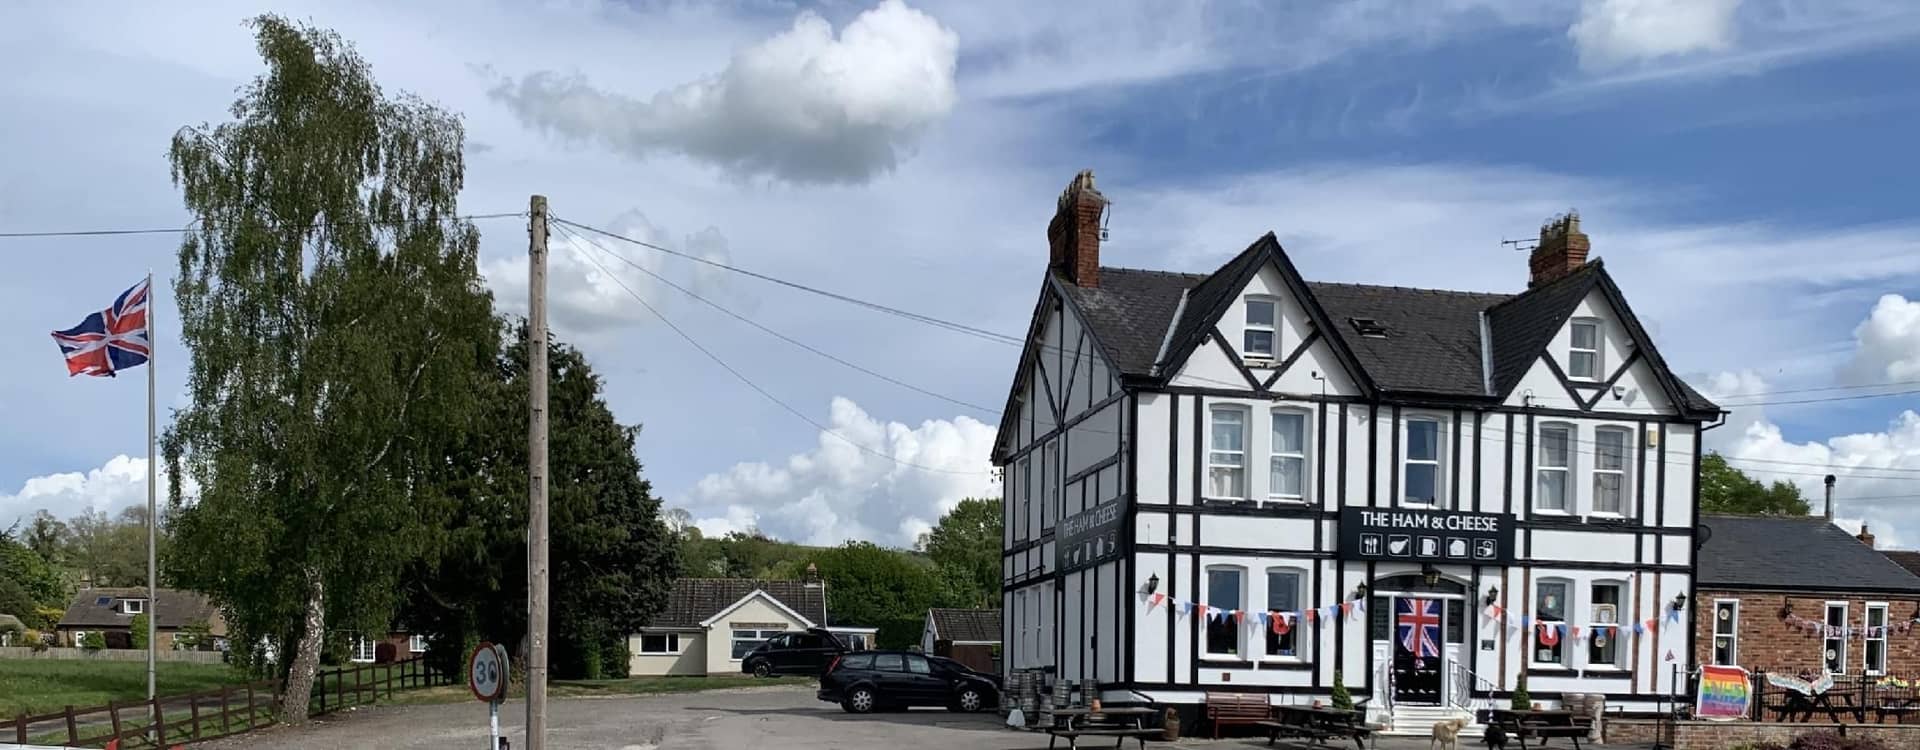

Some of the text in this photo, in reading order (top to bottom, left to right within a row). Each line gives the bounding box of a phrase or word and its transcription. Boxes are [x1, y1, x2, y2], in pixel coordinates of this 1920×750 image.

[1361, 511, 1498, 532] THE HAM & CHEESE
[476, 660, 498, 685] 30
